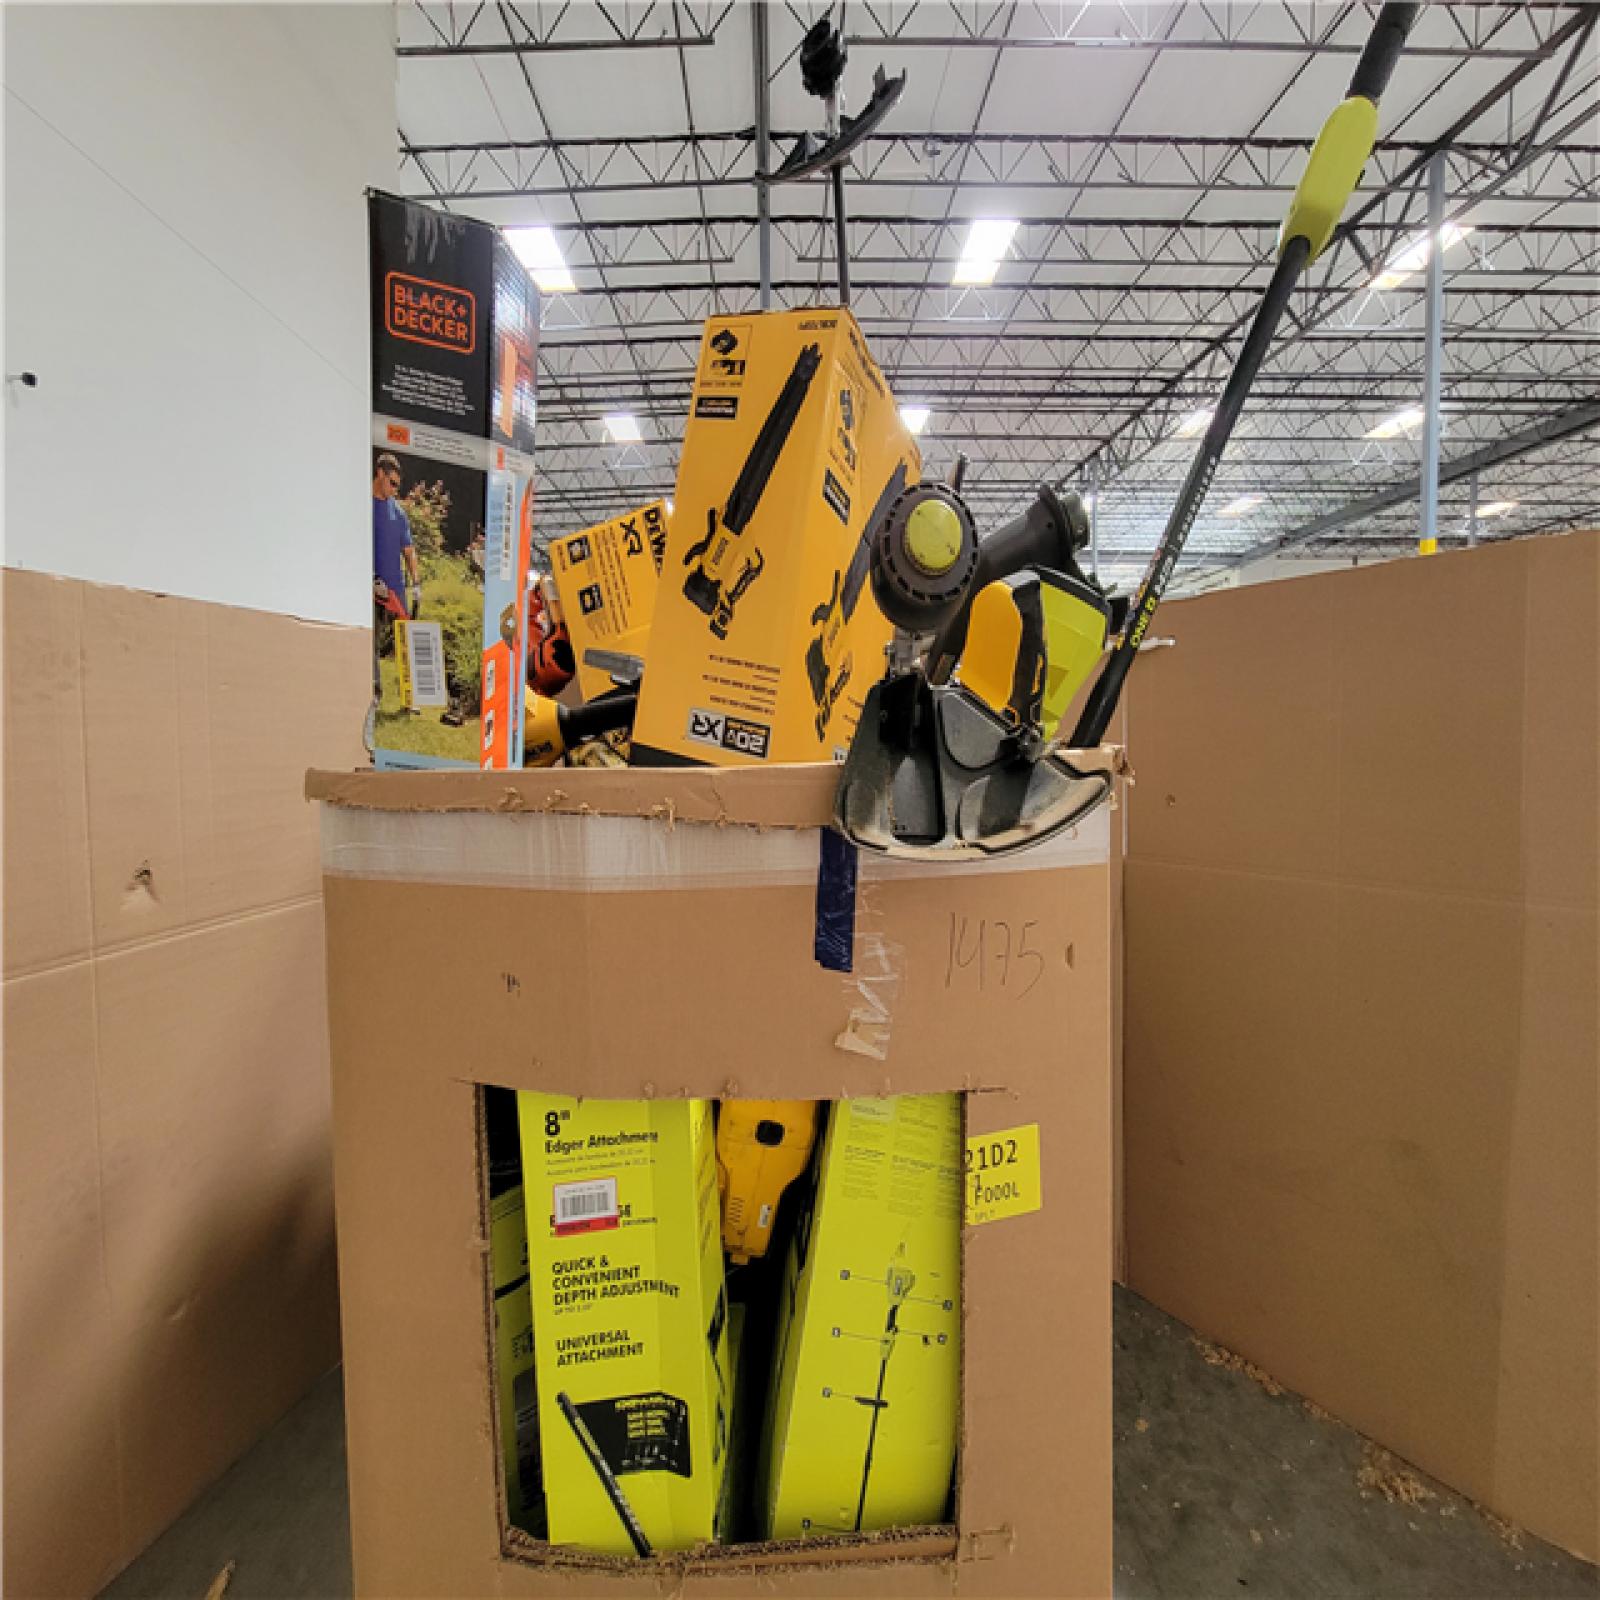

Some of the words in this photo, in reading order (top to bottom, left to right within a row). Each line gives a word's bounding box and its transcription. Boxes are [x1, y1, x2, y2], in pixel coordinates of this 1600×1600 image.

[394, 306, 468, 340] DECKER
[620, 517, 643, 557] XR
[644, 507, 667, 577] DEW
[690, 713, 722, 741] XR
[545, 1139, 585, 1156] Edger
[588, 1130, 659, 1149] Attachment
[552, 1255, 596, 1276] QUICK
[599, 1254, 609, 1268] &
[552, 1265, 641, 1291] CONVENIENT
[553, 1288, 596, 1307] DEPTH
[599, 1279, 681, 1299] ADJUSTMENT
[555, 1329, 631, 1352] UNIVERSAL
[556, 1342, 645, 1368] ATTACHMENT
